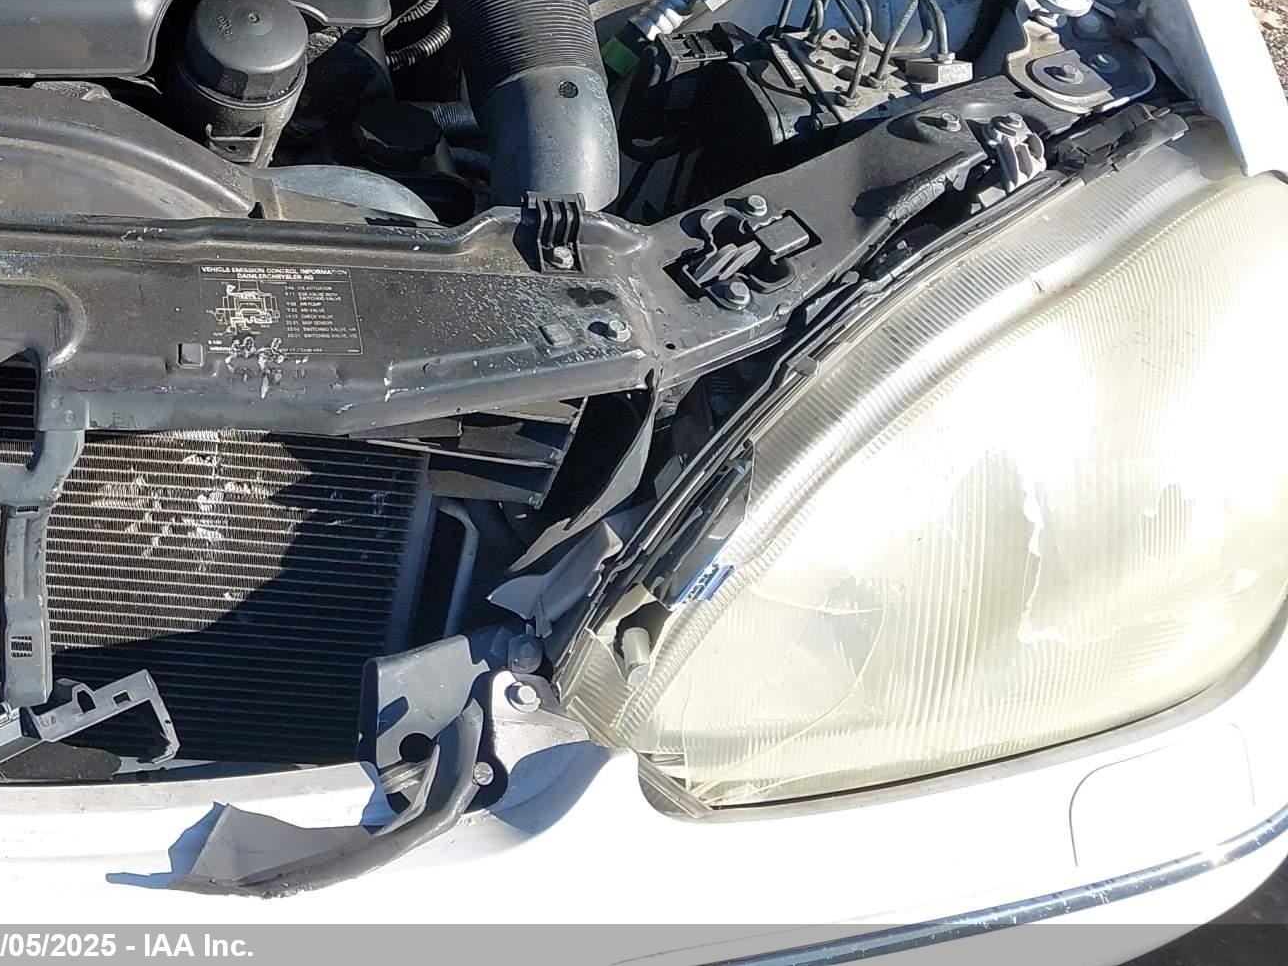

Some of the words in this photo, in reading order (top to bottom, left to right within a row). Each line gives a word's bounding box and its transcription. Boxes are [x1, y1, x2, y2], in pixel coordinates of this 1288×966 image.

[201, 266, 231, 274] VEHICLE
[231, 267, 265, 275] EMISSION
[266, 268, 299, 276] CONTROL
[300, 268, 348, 277] INFORMATION
[237, 273, 302, 281] DAIMLERCHRYSLER
